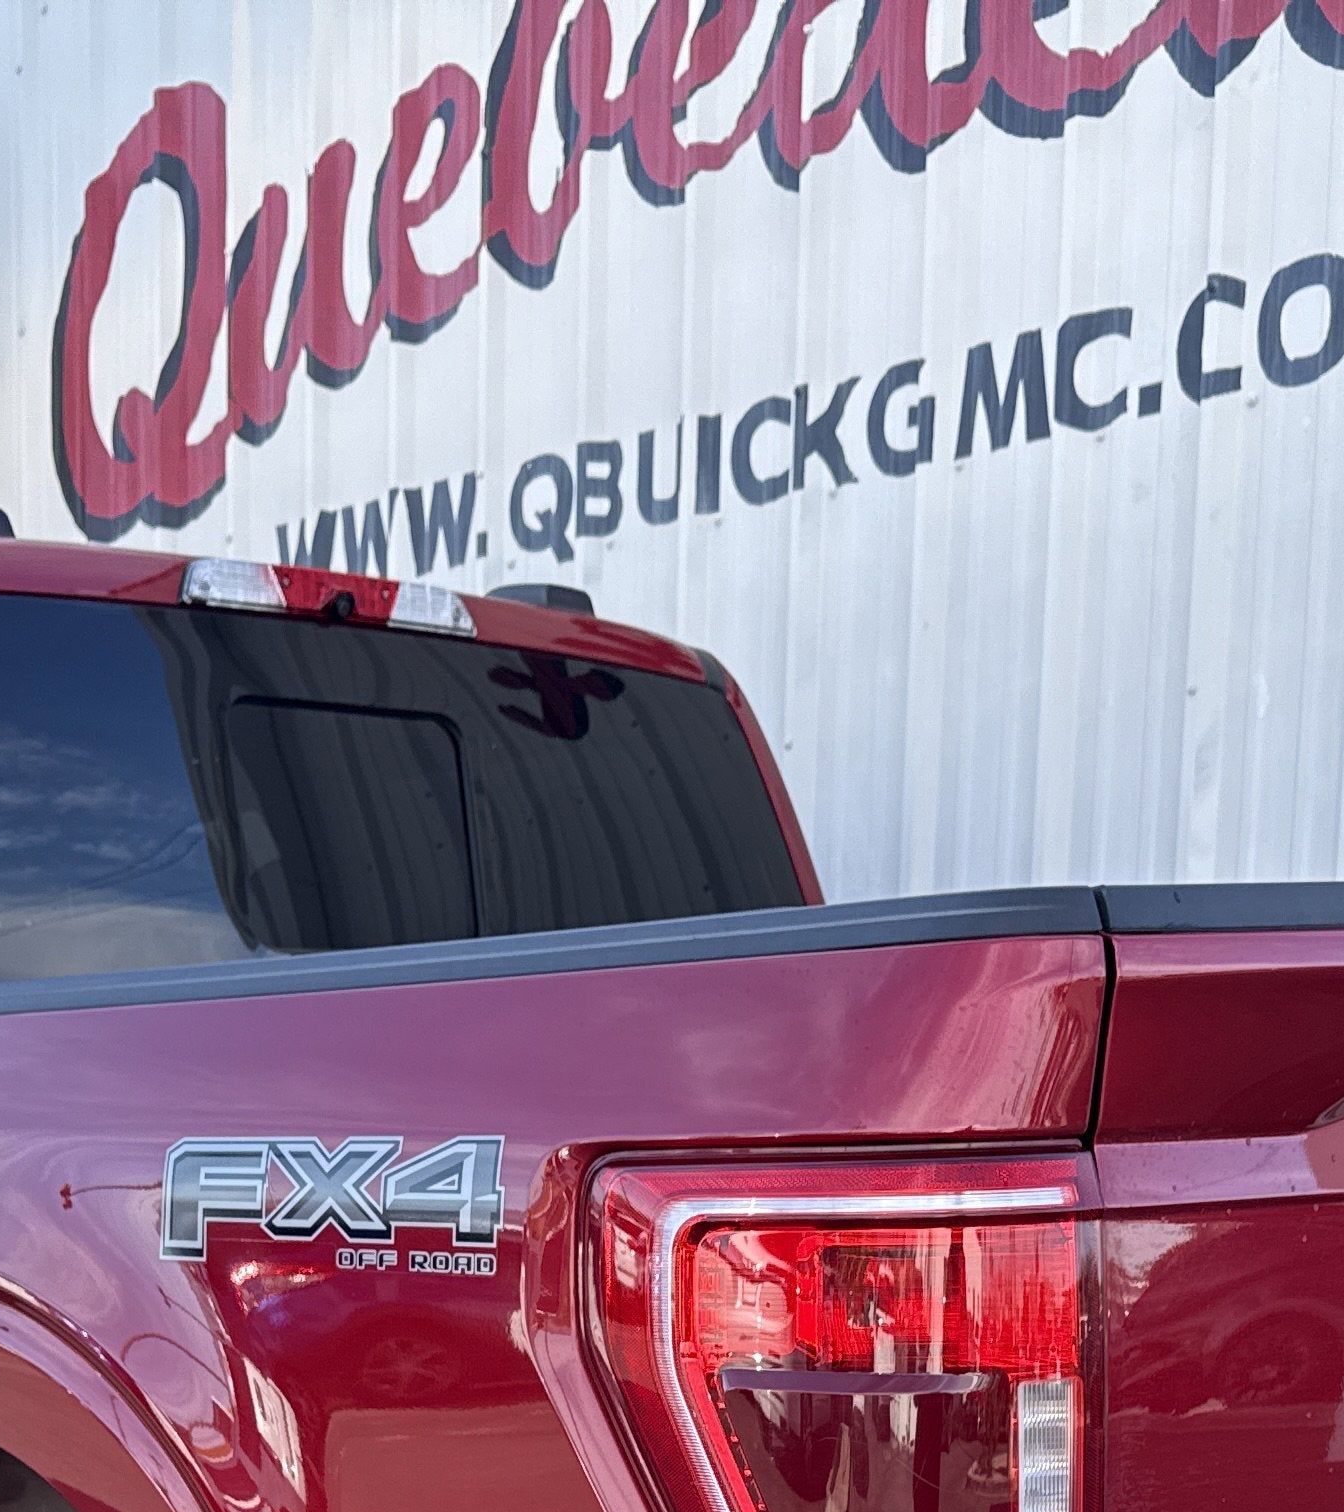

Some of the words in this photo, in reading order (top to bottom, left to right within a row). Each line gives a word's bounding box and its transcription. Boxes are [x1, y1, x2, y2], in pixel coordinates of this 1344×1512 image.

[160, 1135, 506, 1261] FX4
[336, 1248, 398, 1271] OFF
[409, 1250, 497, 1276] ROAD
